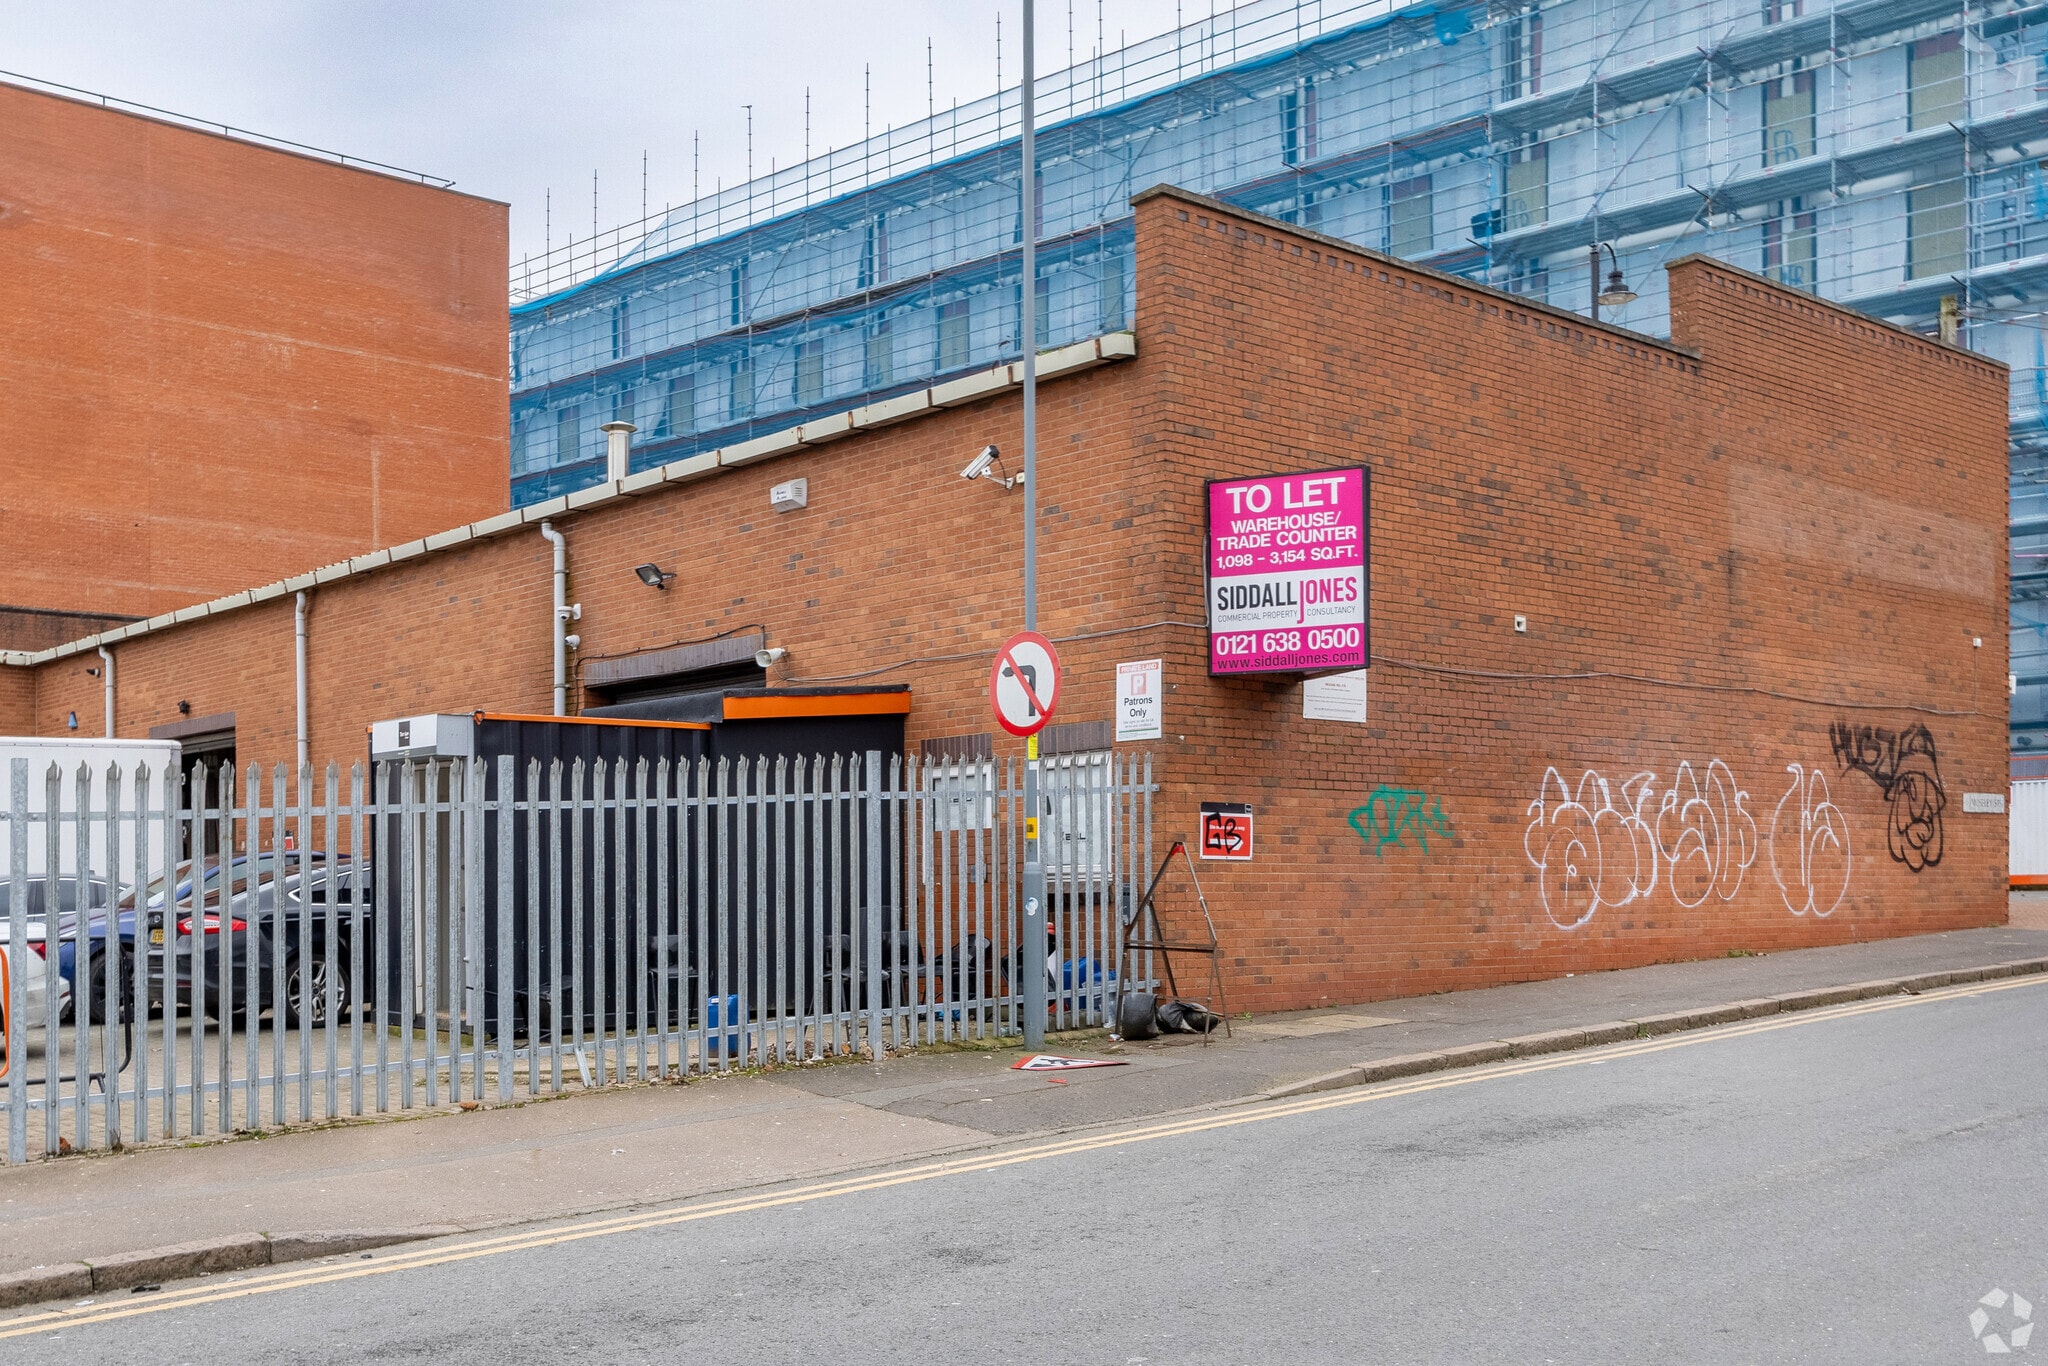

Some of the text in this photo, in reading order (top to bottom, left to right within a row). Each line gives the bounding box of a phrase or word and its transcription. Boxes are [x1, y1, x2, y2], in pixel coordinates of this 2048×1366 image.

[1225, 476, 1346, 514] TO LET
[1231, 511, 1341, 534] WAREHOUSE/
[1217, 525, 1357, 550] TRADE COUNTER
[1216, 553, 1253, 570] 1,098
[1269, 549, 1305, 566] 3,154
[1310, 545, 1358, 562] SQ.FT.
[1217, 576, 1358, 624] SIDDALL JONES
[1217, 605, 1356, 622] COMMERCIAL PROPERTY CONSULTANCY
[1216, 627, 1360, 656] 0121 638 0500
[1143, 663, 1157, 671] LAND
[1217, 651, 1359, 669] www.siddalljones.com
[1124, 696, 1153, 706] Patrons
[1129, 708, 1147, 718] Only
